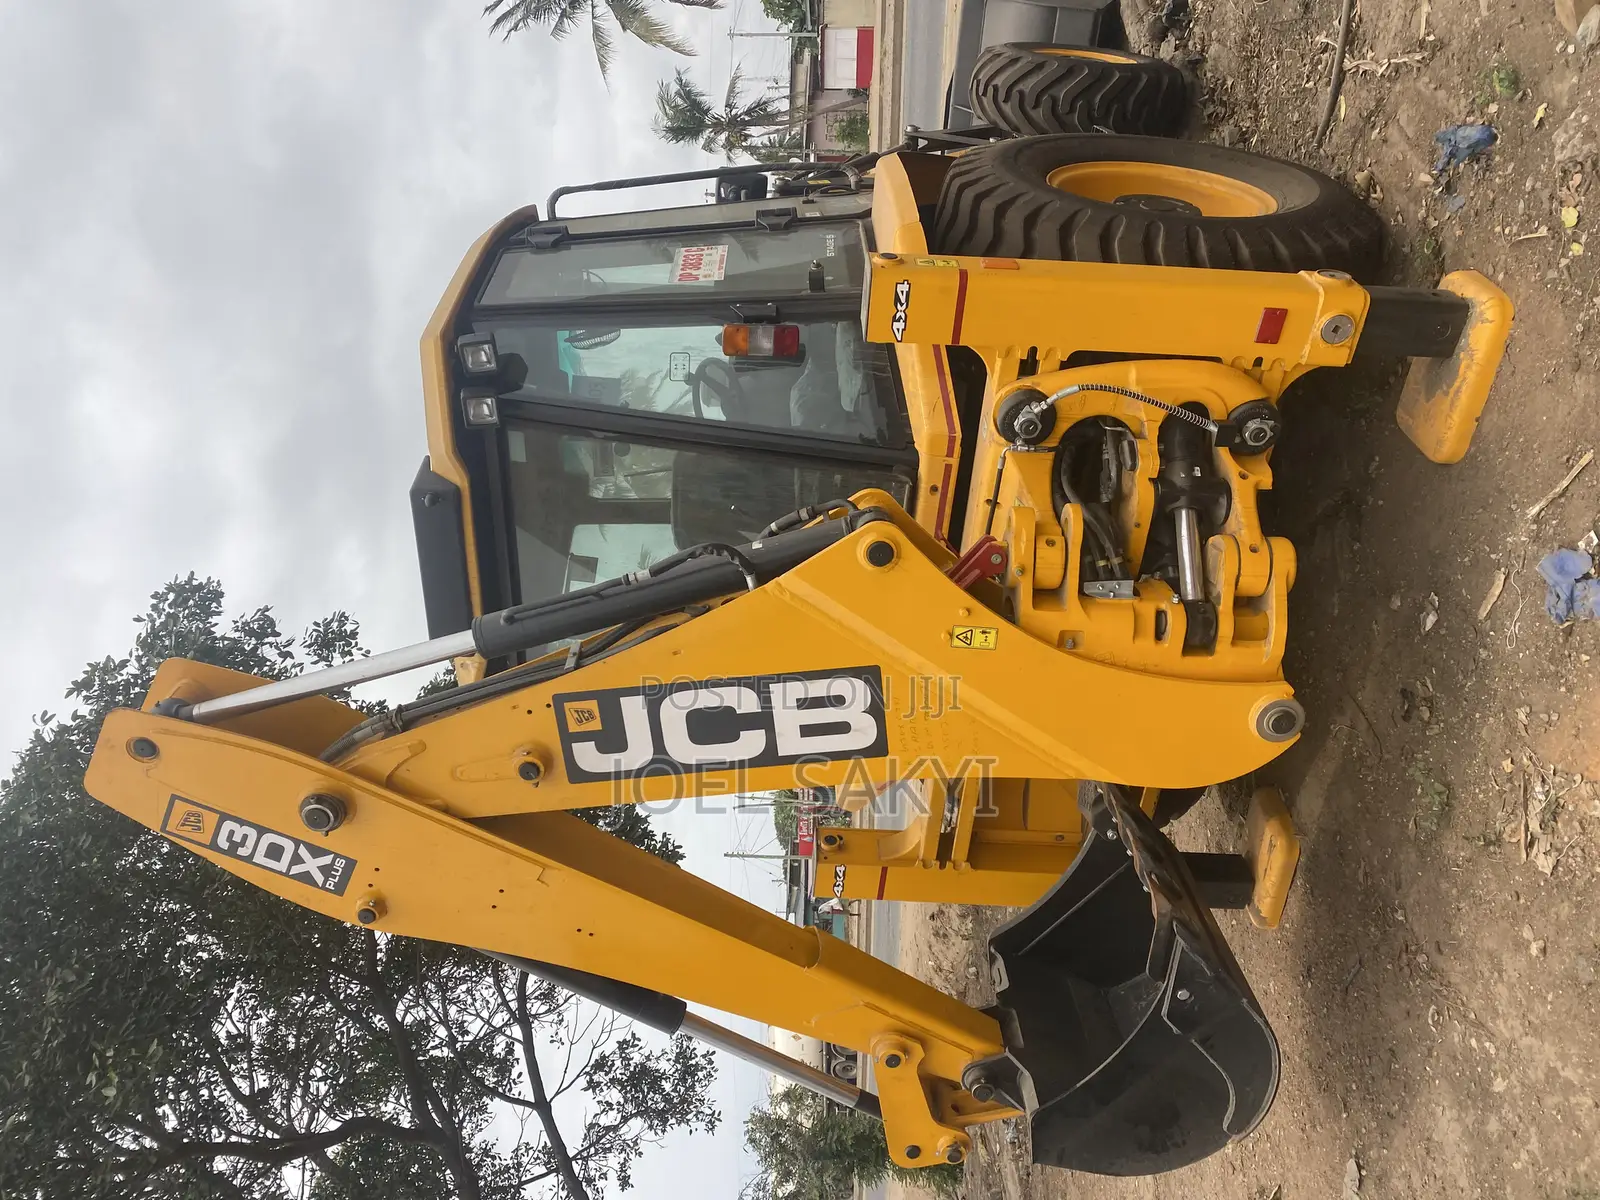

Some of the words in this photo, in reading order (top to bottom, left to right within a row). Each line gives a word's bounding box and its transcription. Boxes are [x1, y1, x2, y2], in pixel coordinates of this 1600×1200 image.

[569, 709, 596, 726] JCB
[571, 676, 878, 773] JCB
[179, 811, 202, 831] JCB
[217, 821, 334, 887] 3DX
[326, 858, 346, 890] PLUS
